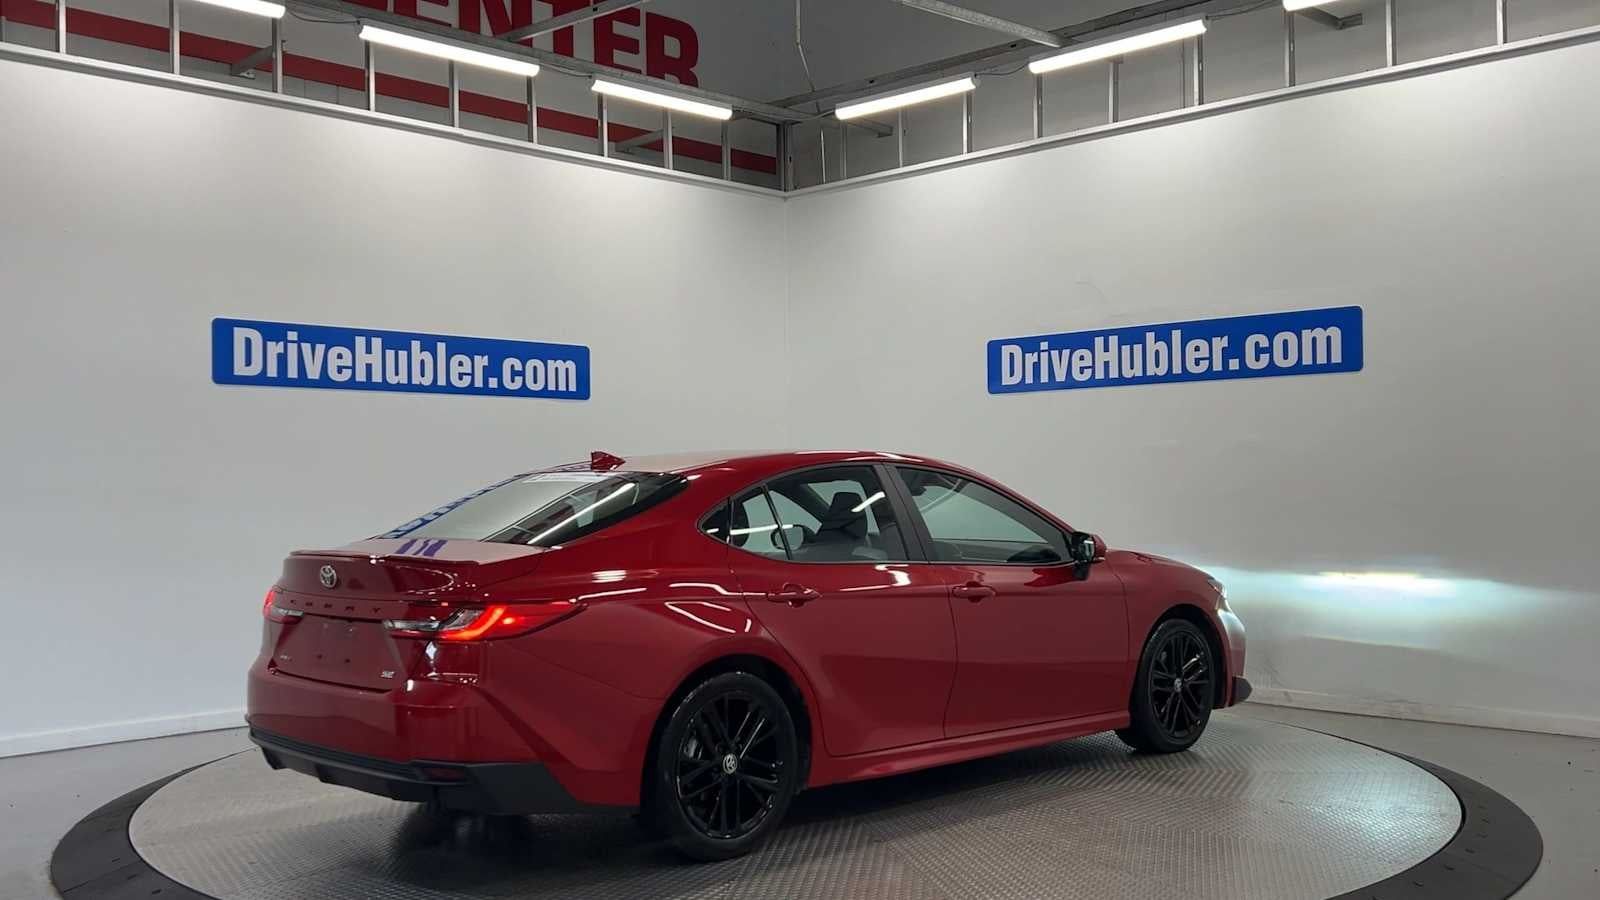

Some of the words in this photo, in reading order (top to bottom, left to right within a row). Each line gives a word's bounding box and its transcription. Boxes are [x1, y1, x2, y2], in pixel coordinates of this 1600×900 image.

[340, 0, 699, 88] NTER
[233, 326, 577, 391] DriveHubler.com
[1001, 325, 1342, 386] DriveHubler.com
